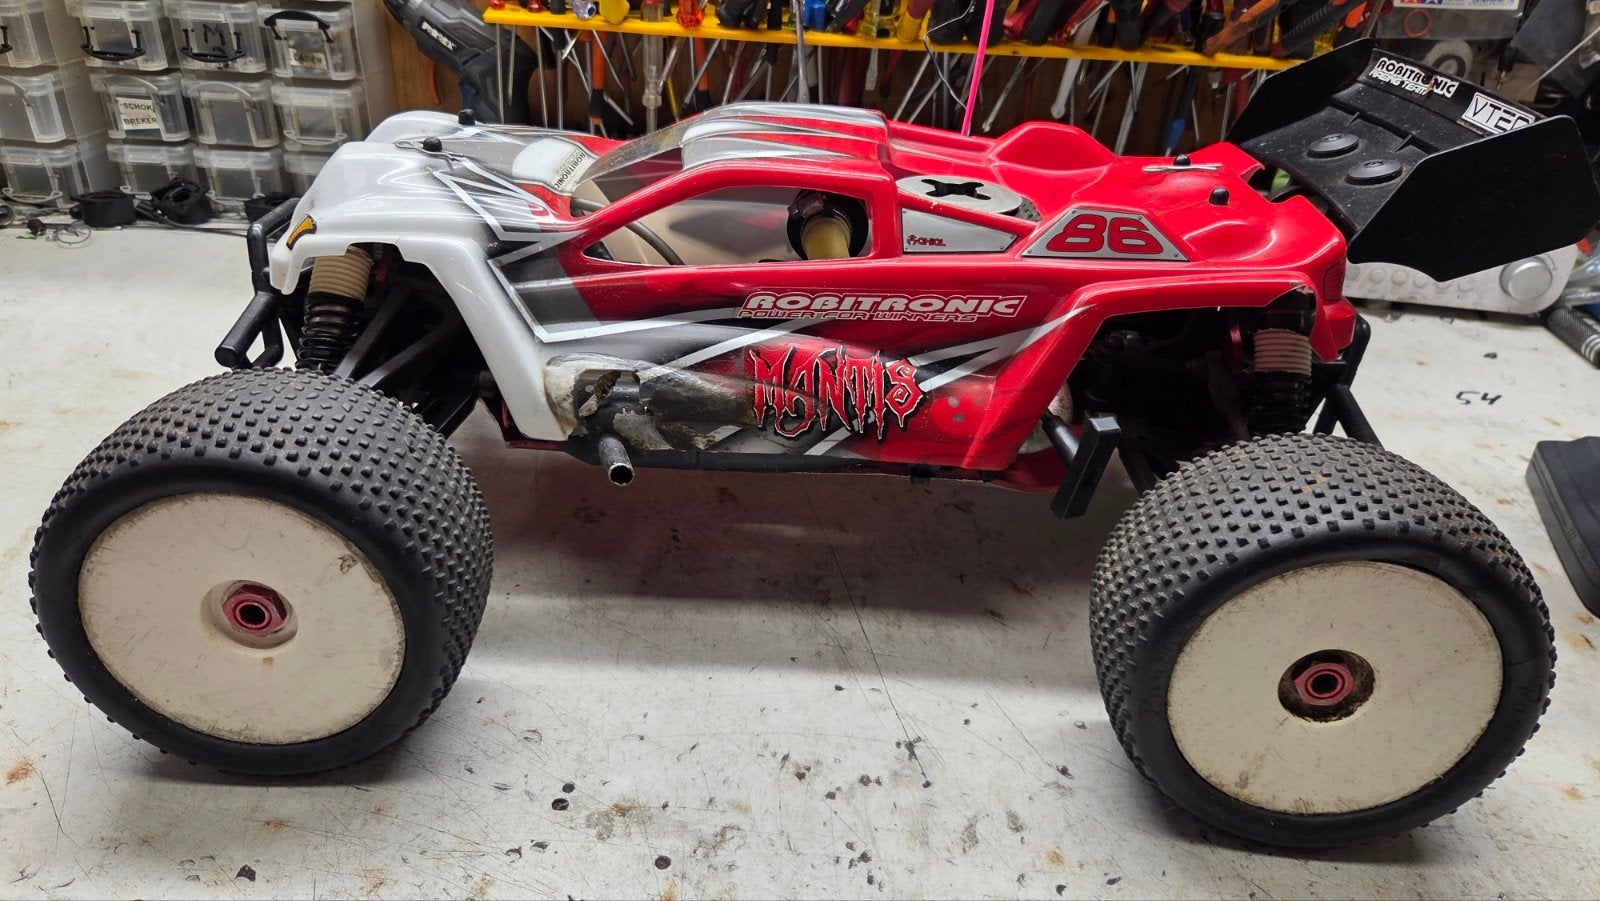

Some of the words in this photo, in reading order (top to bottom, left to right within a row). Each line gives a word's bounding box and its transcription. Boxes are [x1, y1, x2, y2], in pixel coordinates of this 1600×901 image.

[1368, 69, 1401, 86] RACING
[1376, 58, 1458, 96] ROBITRONIC
[554, 152, 586, 189] ROBITRONIC
[1046, 213, 1164, 255] 86
[737, 309, 816, 320] POWER
[821, 310, 869, 321] FOR
[873, 311, 978, 322] WINNERS
[744, 293, 1025, 316] ROBITRONIC
[748, 345, 924, 440] MANTIS
[1455, 390, 1502, 405] 54
